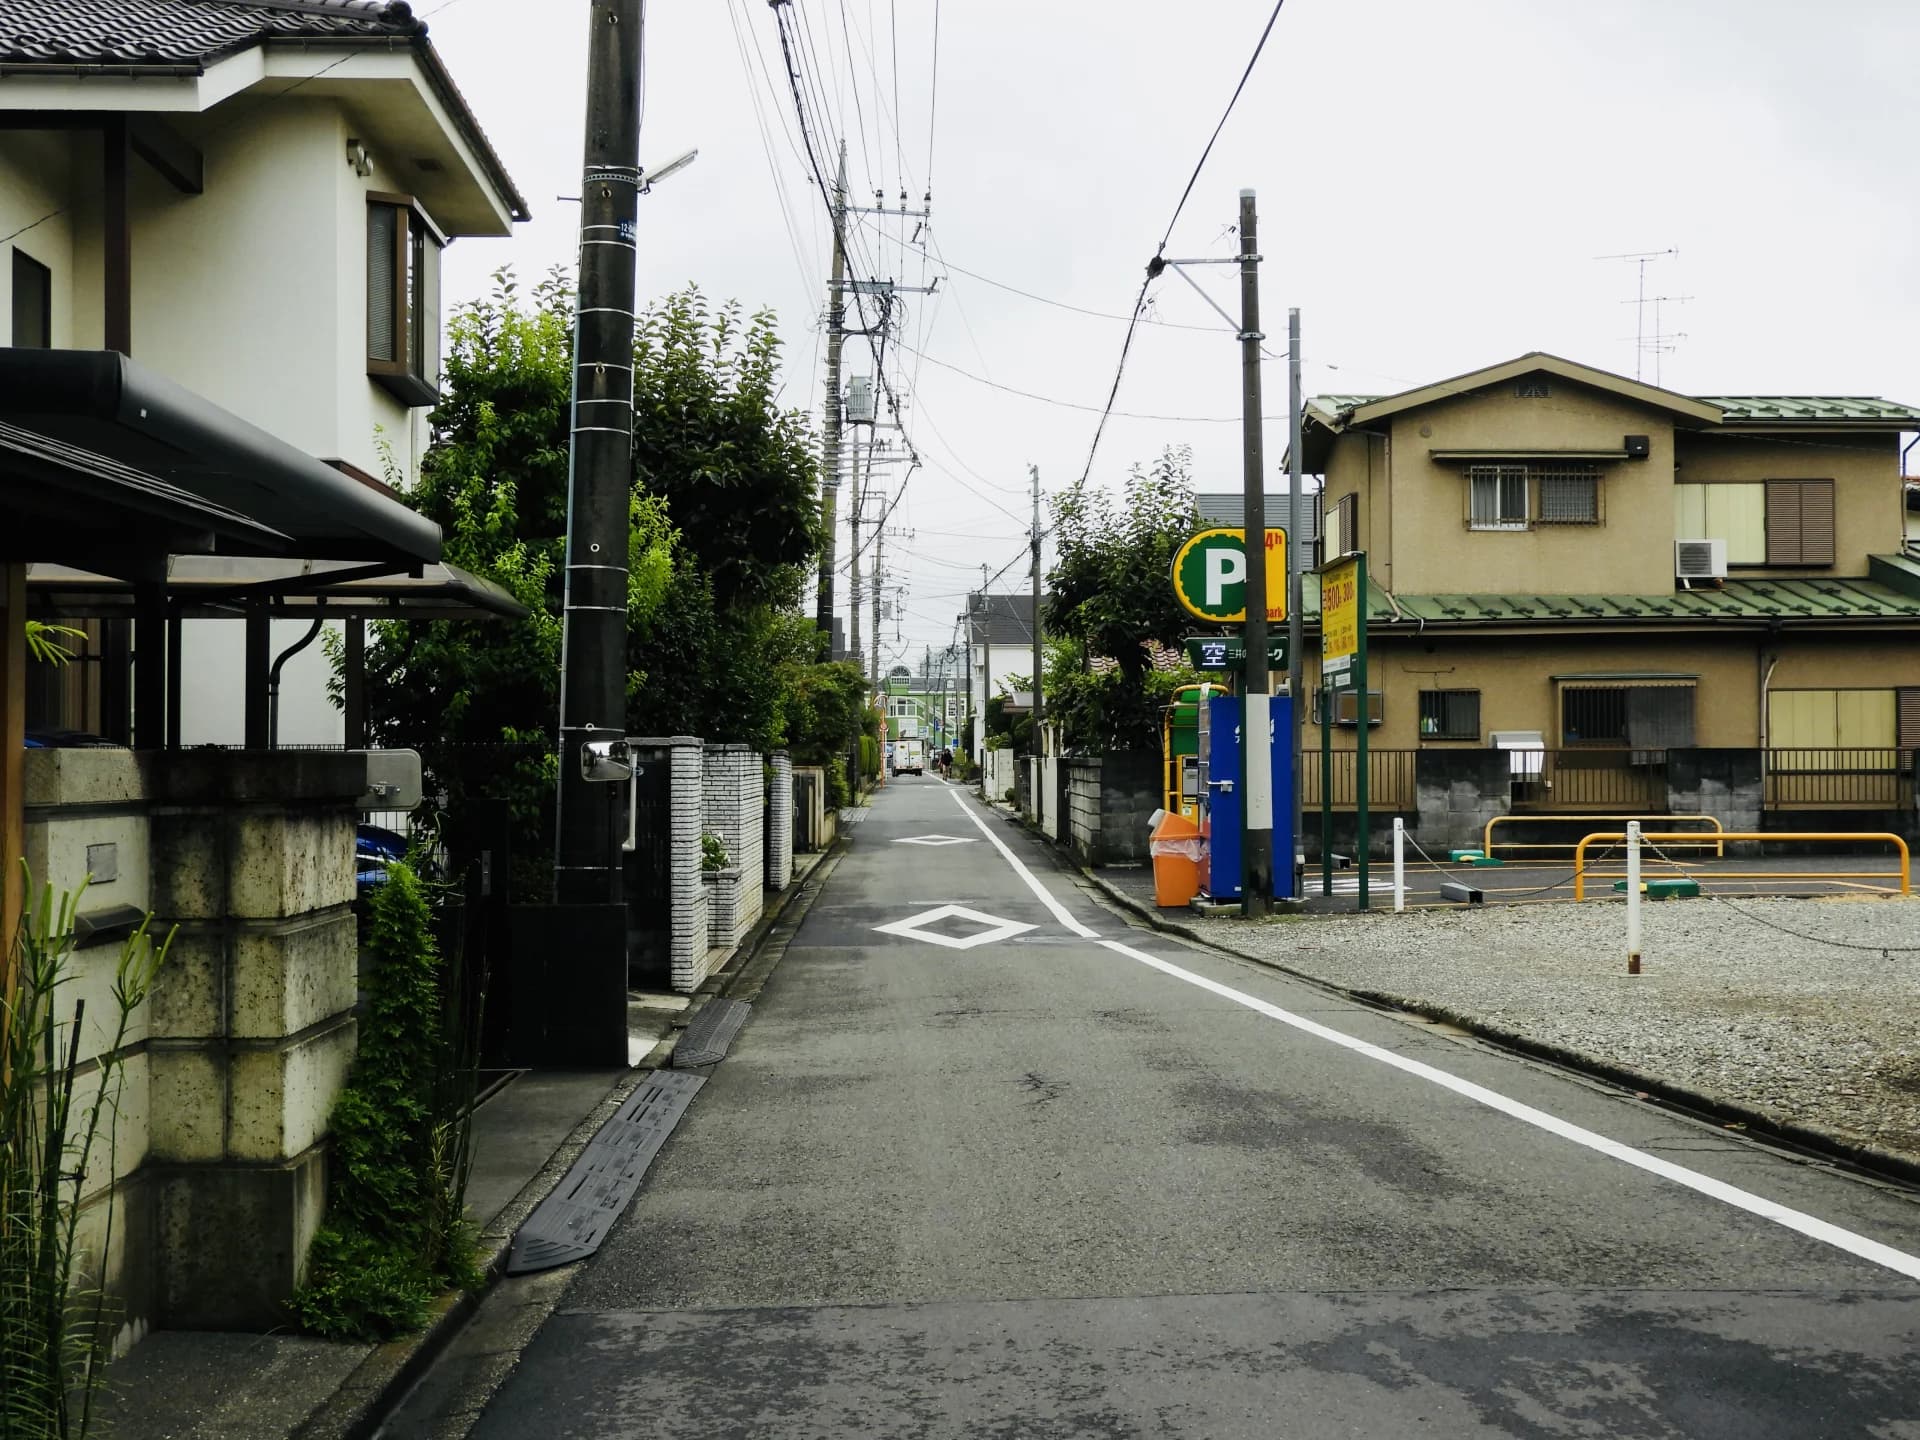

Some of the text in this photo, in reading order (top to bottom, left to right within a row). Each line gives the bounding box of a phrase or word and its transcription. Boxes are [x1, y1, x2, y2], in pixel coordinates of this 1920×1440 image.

[1264, 532, 1283, 551] 4h
[1206, 548, 1247, 606] P
[1202, 642, 1226, 666] 空
